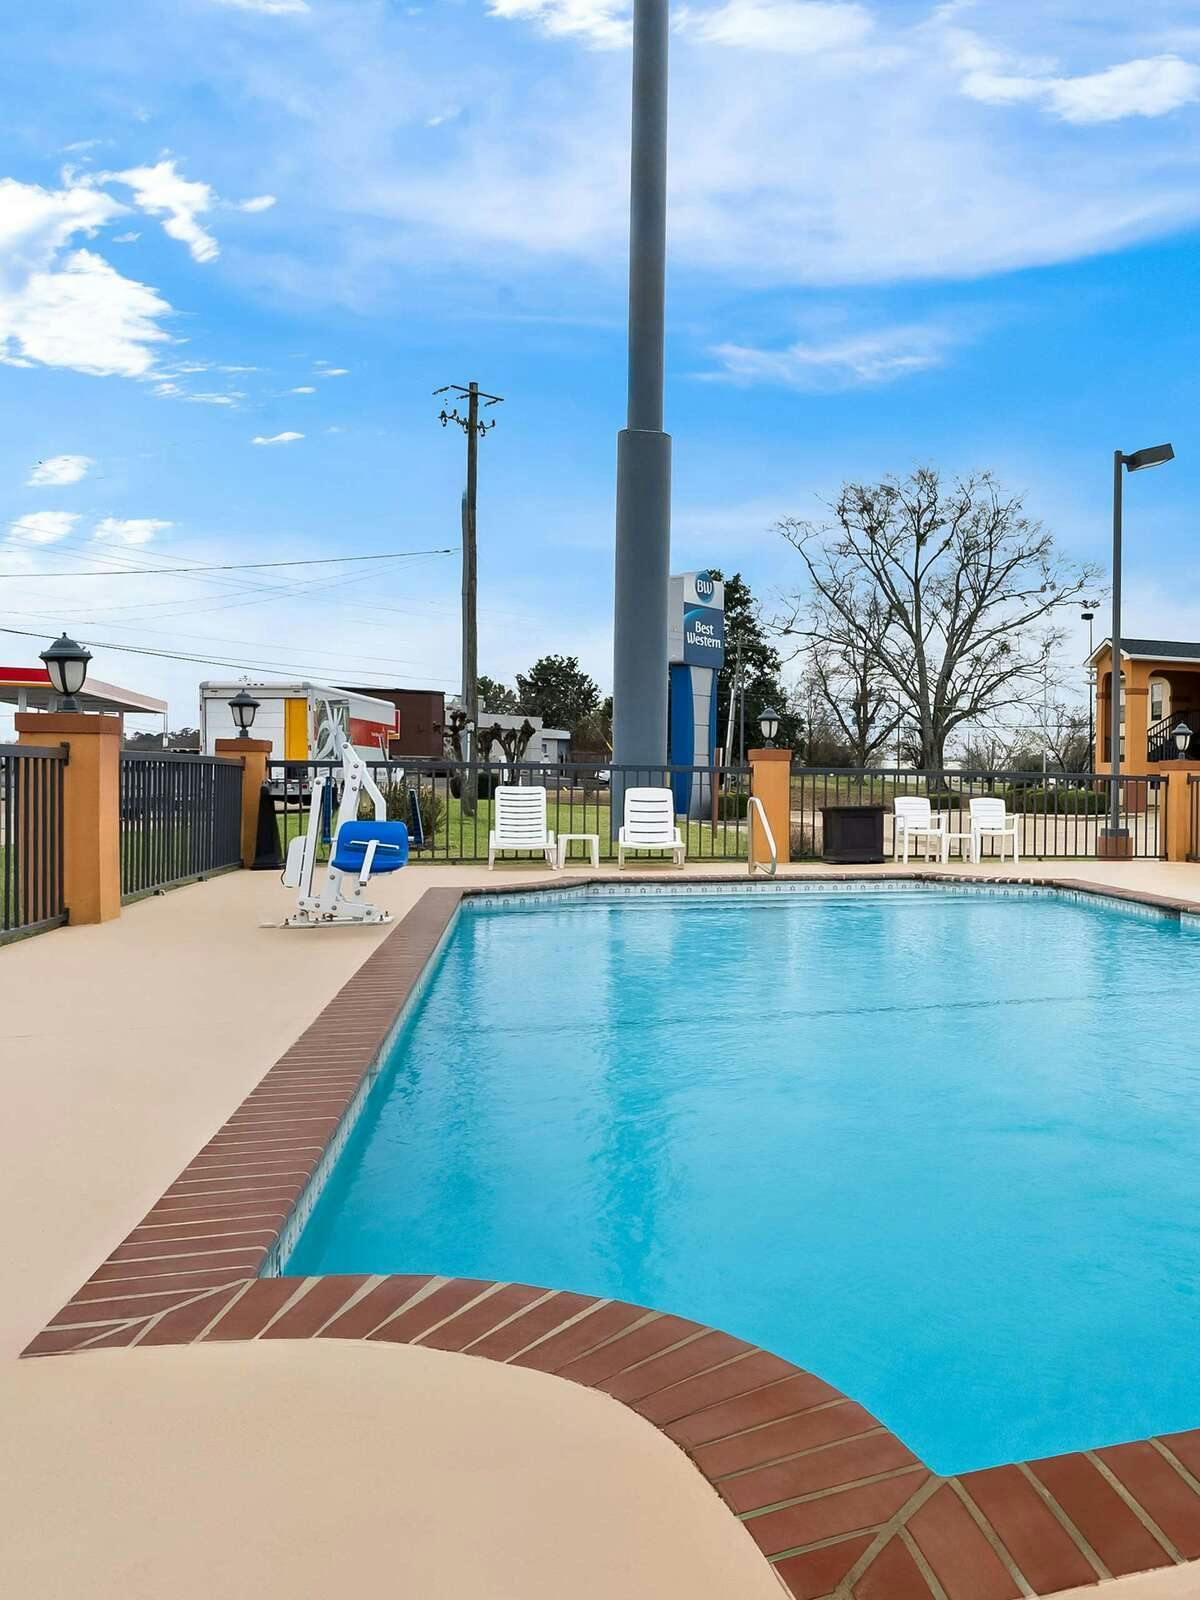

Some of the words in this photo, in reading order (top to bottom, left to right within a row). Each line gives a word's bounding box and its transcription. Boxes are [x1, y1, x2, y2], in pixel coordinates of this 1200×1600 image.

[697, 580, 713, 595] BW
[695, 621, 714, 636] Best
[686, 632, 721, 649] Western
